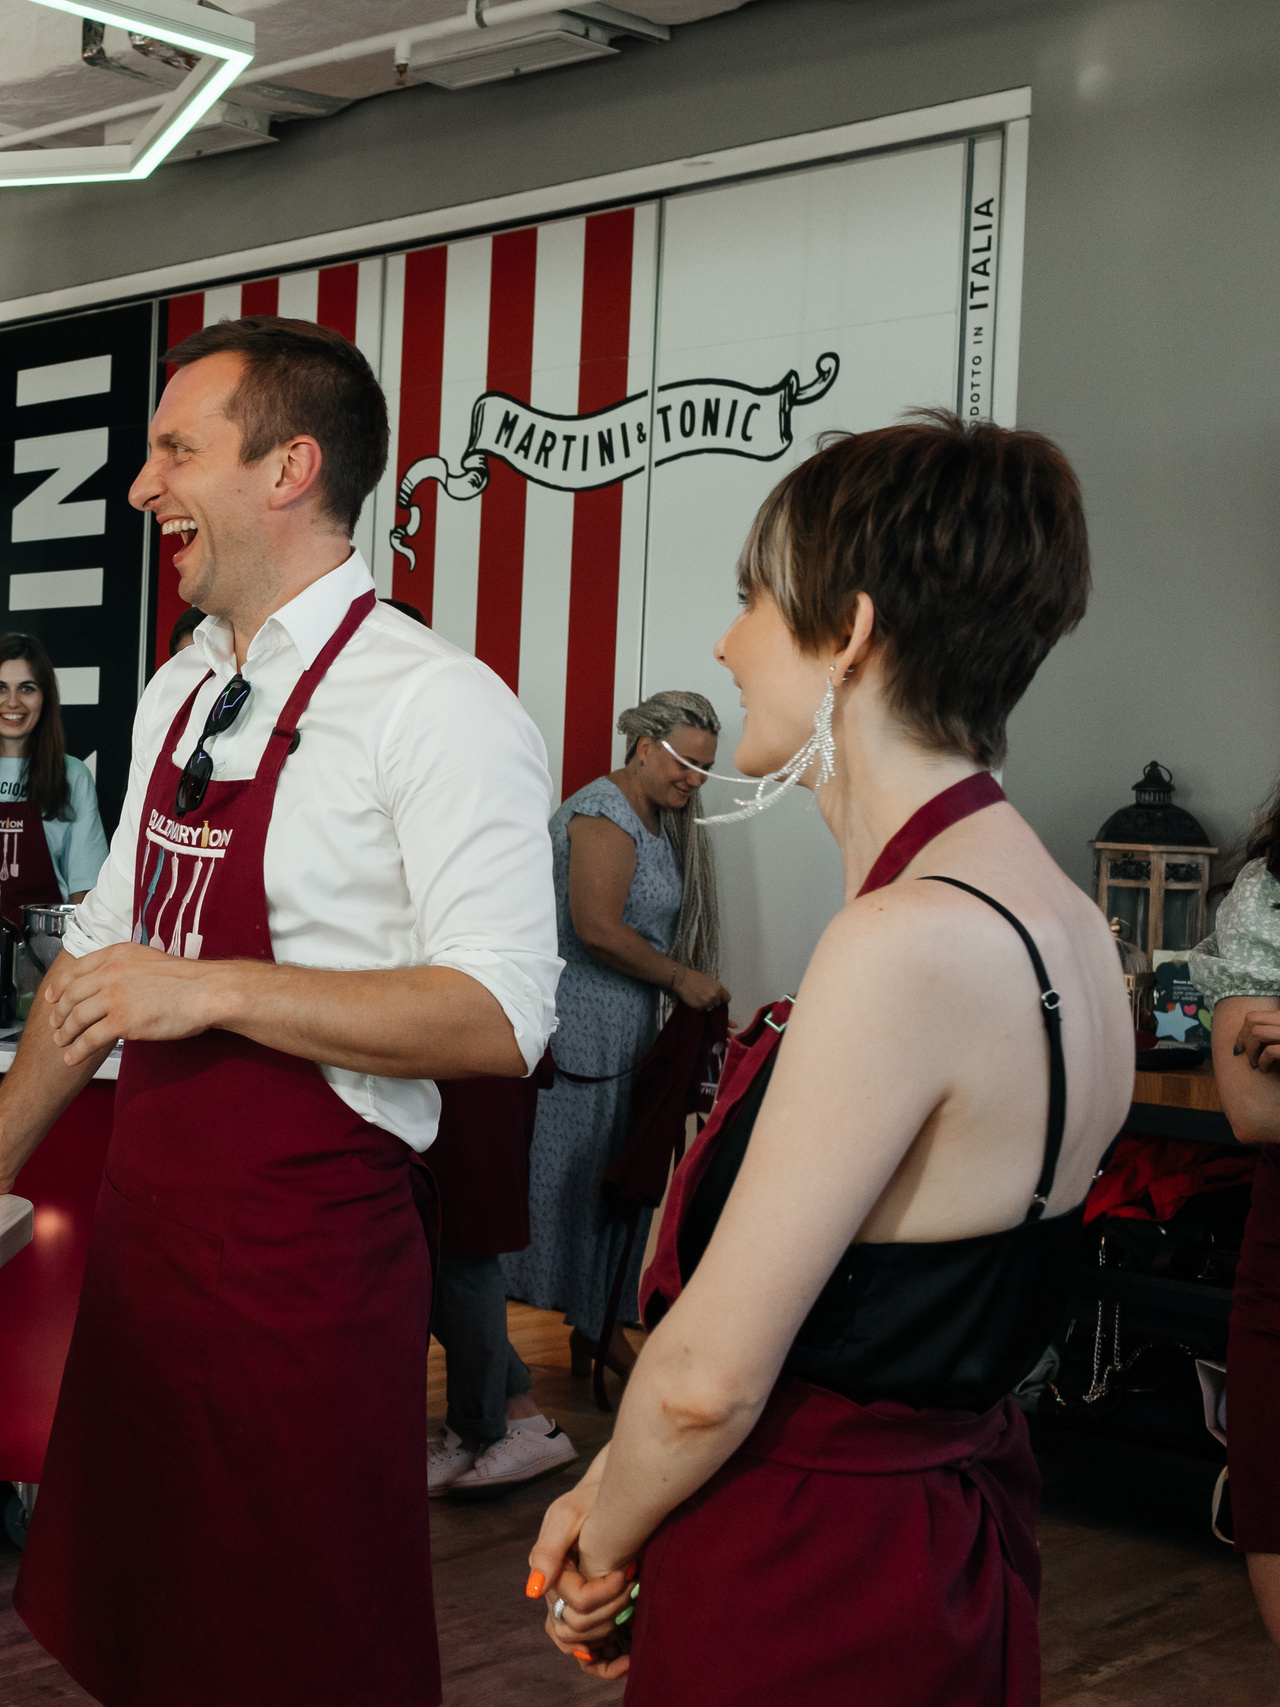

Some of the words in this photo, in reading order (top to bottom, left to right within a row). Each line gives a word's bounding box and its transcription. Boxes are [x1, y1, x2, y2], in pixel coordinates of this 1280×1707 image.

[969, 197, 995, 311] ITALIA
[973, 326, 983, 345] IN
[495, 409, 631, 471] MARTINI
[636, 421, 647, 444] &
[657, 397, 761, 443] TONIC
